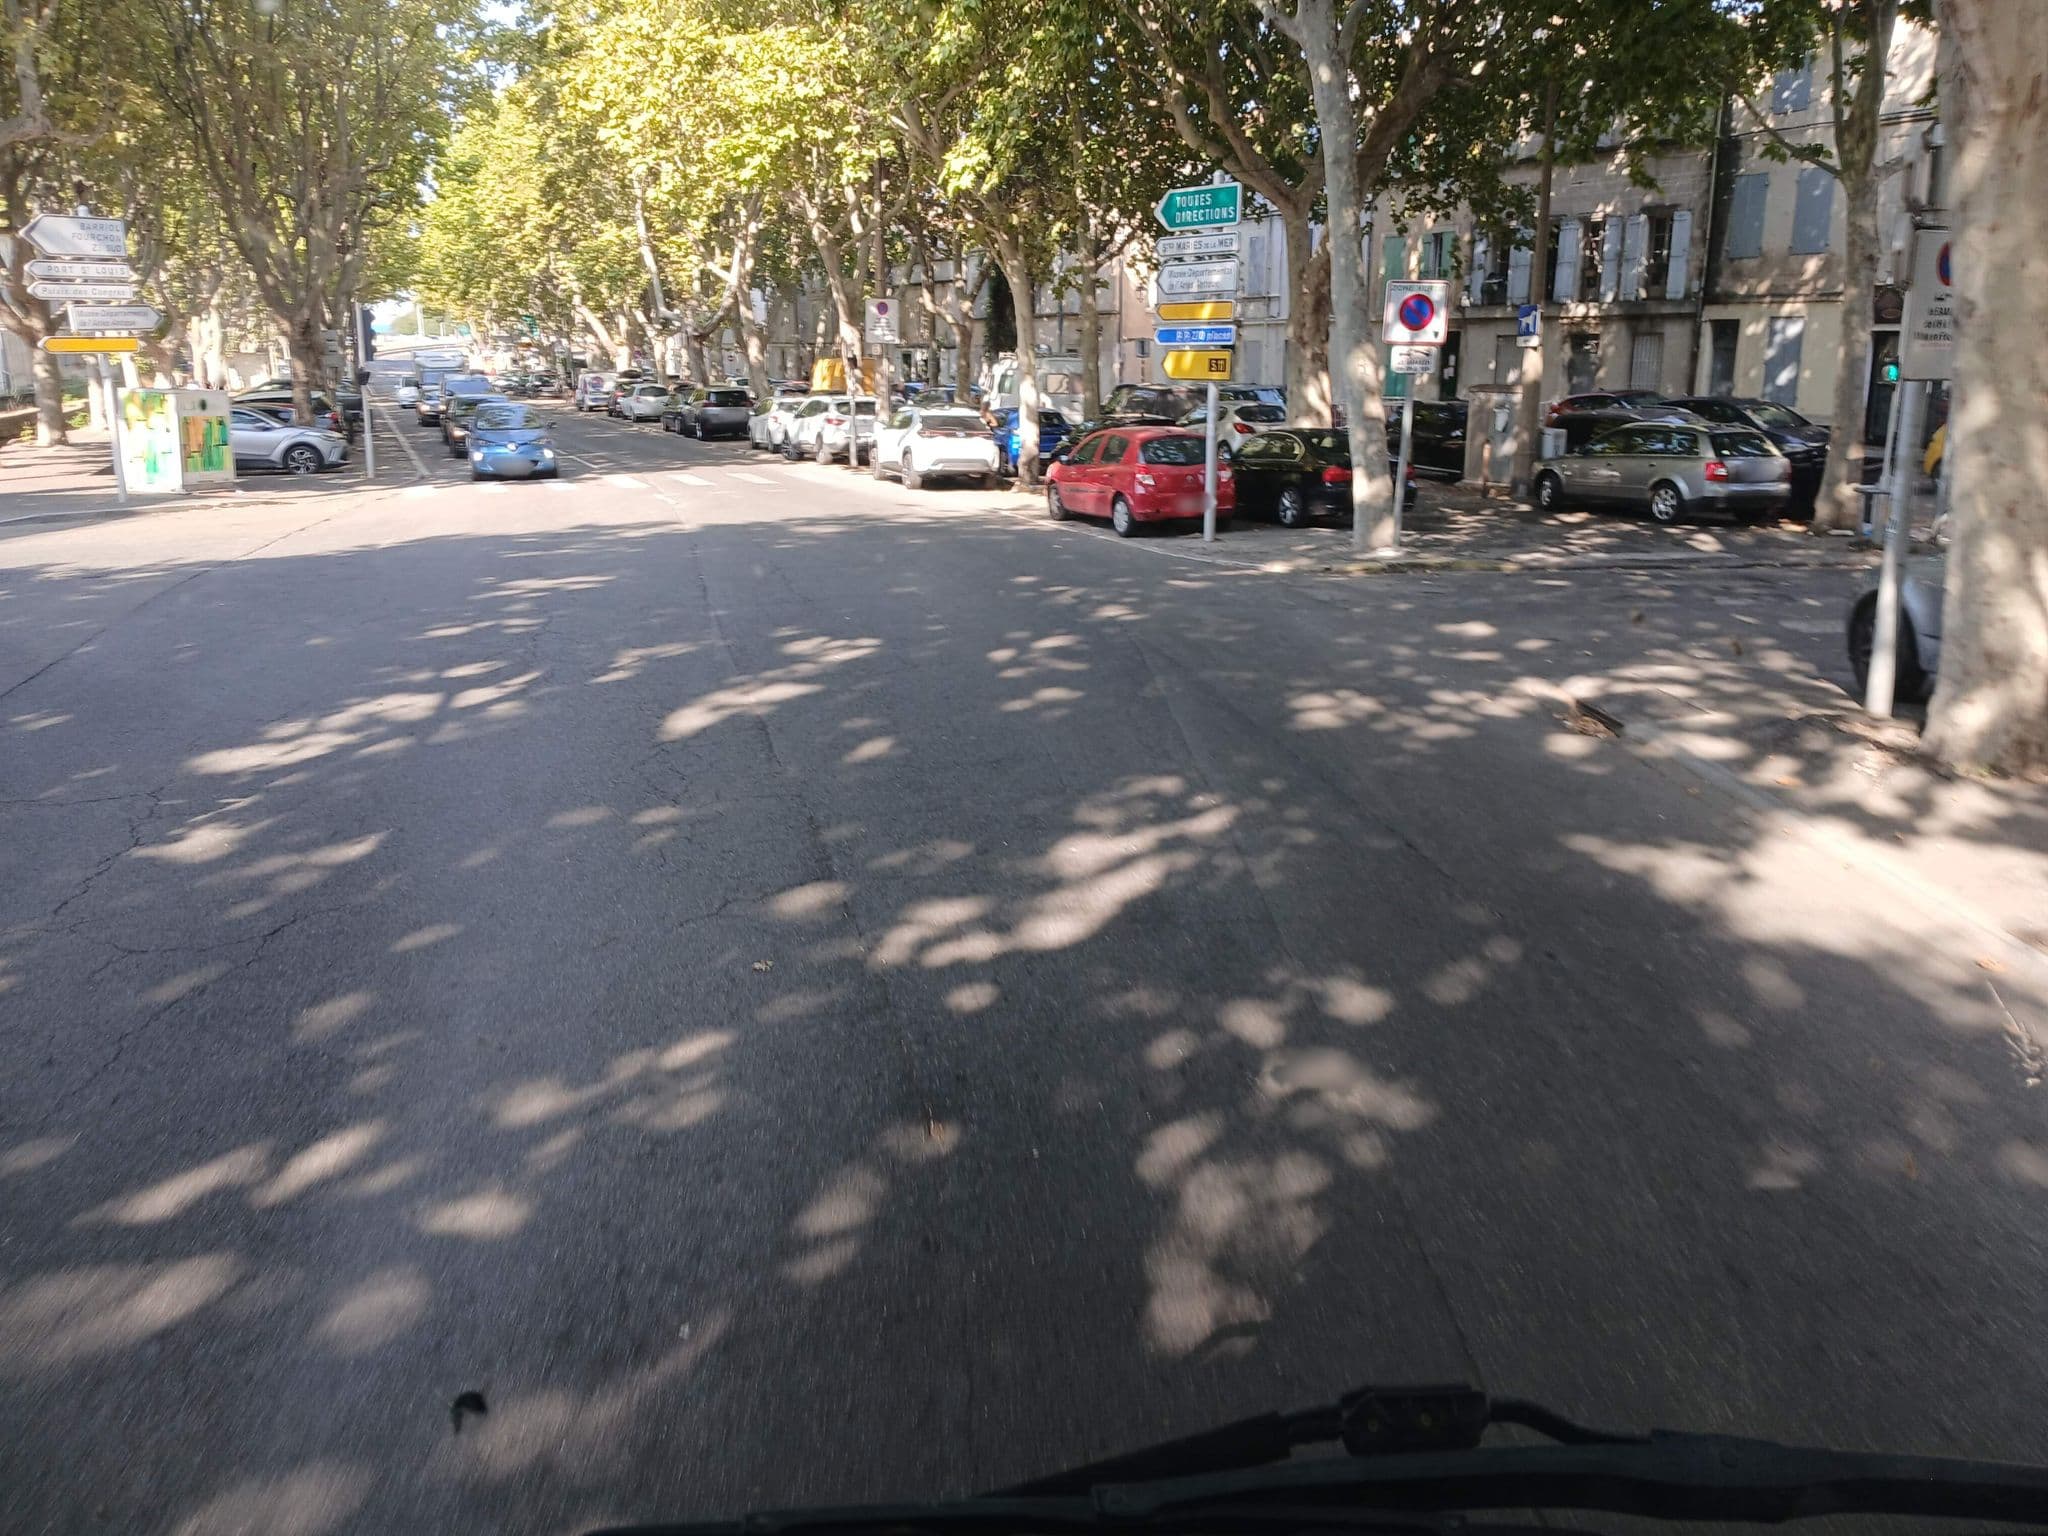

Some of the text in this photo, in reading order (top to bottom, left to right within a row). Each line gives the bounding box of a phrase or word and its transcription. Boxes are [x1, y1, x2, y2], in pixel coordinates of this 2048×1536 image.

[1175, 193, 1212, 208] TOUTES
[1175, 206, 1235, 223] DIRECTIONS
[80, 222, 121, 231] BARRIOL
[71, 232, 121, 241] FOURCHON
[1218, 238, 1234, 248] MER
[47, 265, 73, 273] PORT
[95, 266, 126, 275] LOUIS
